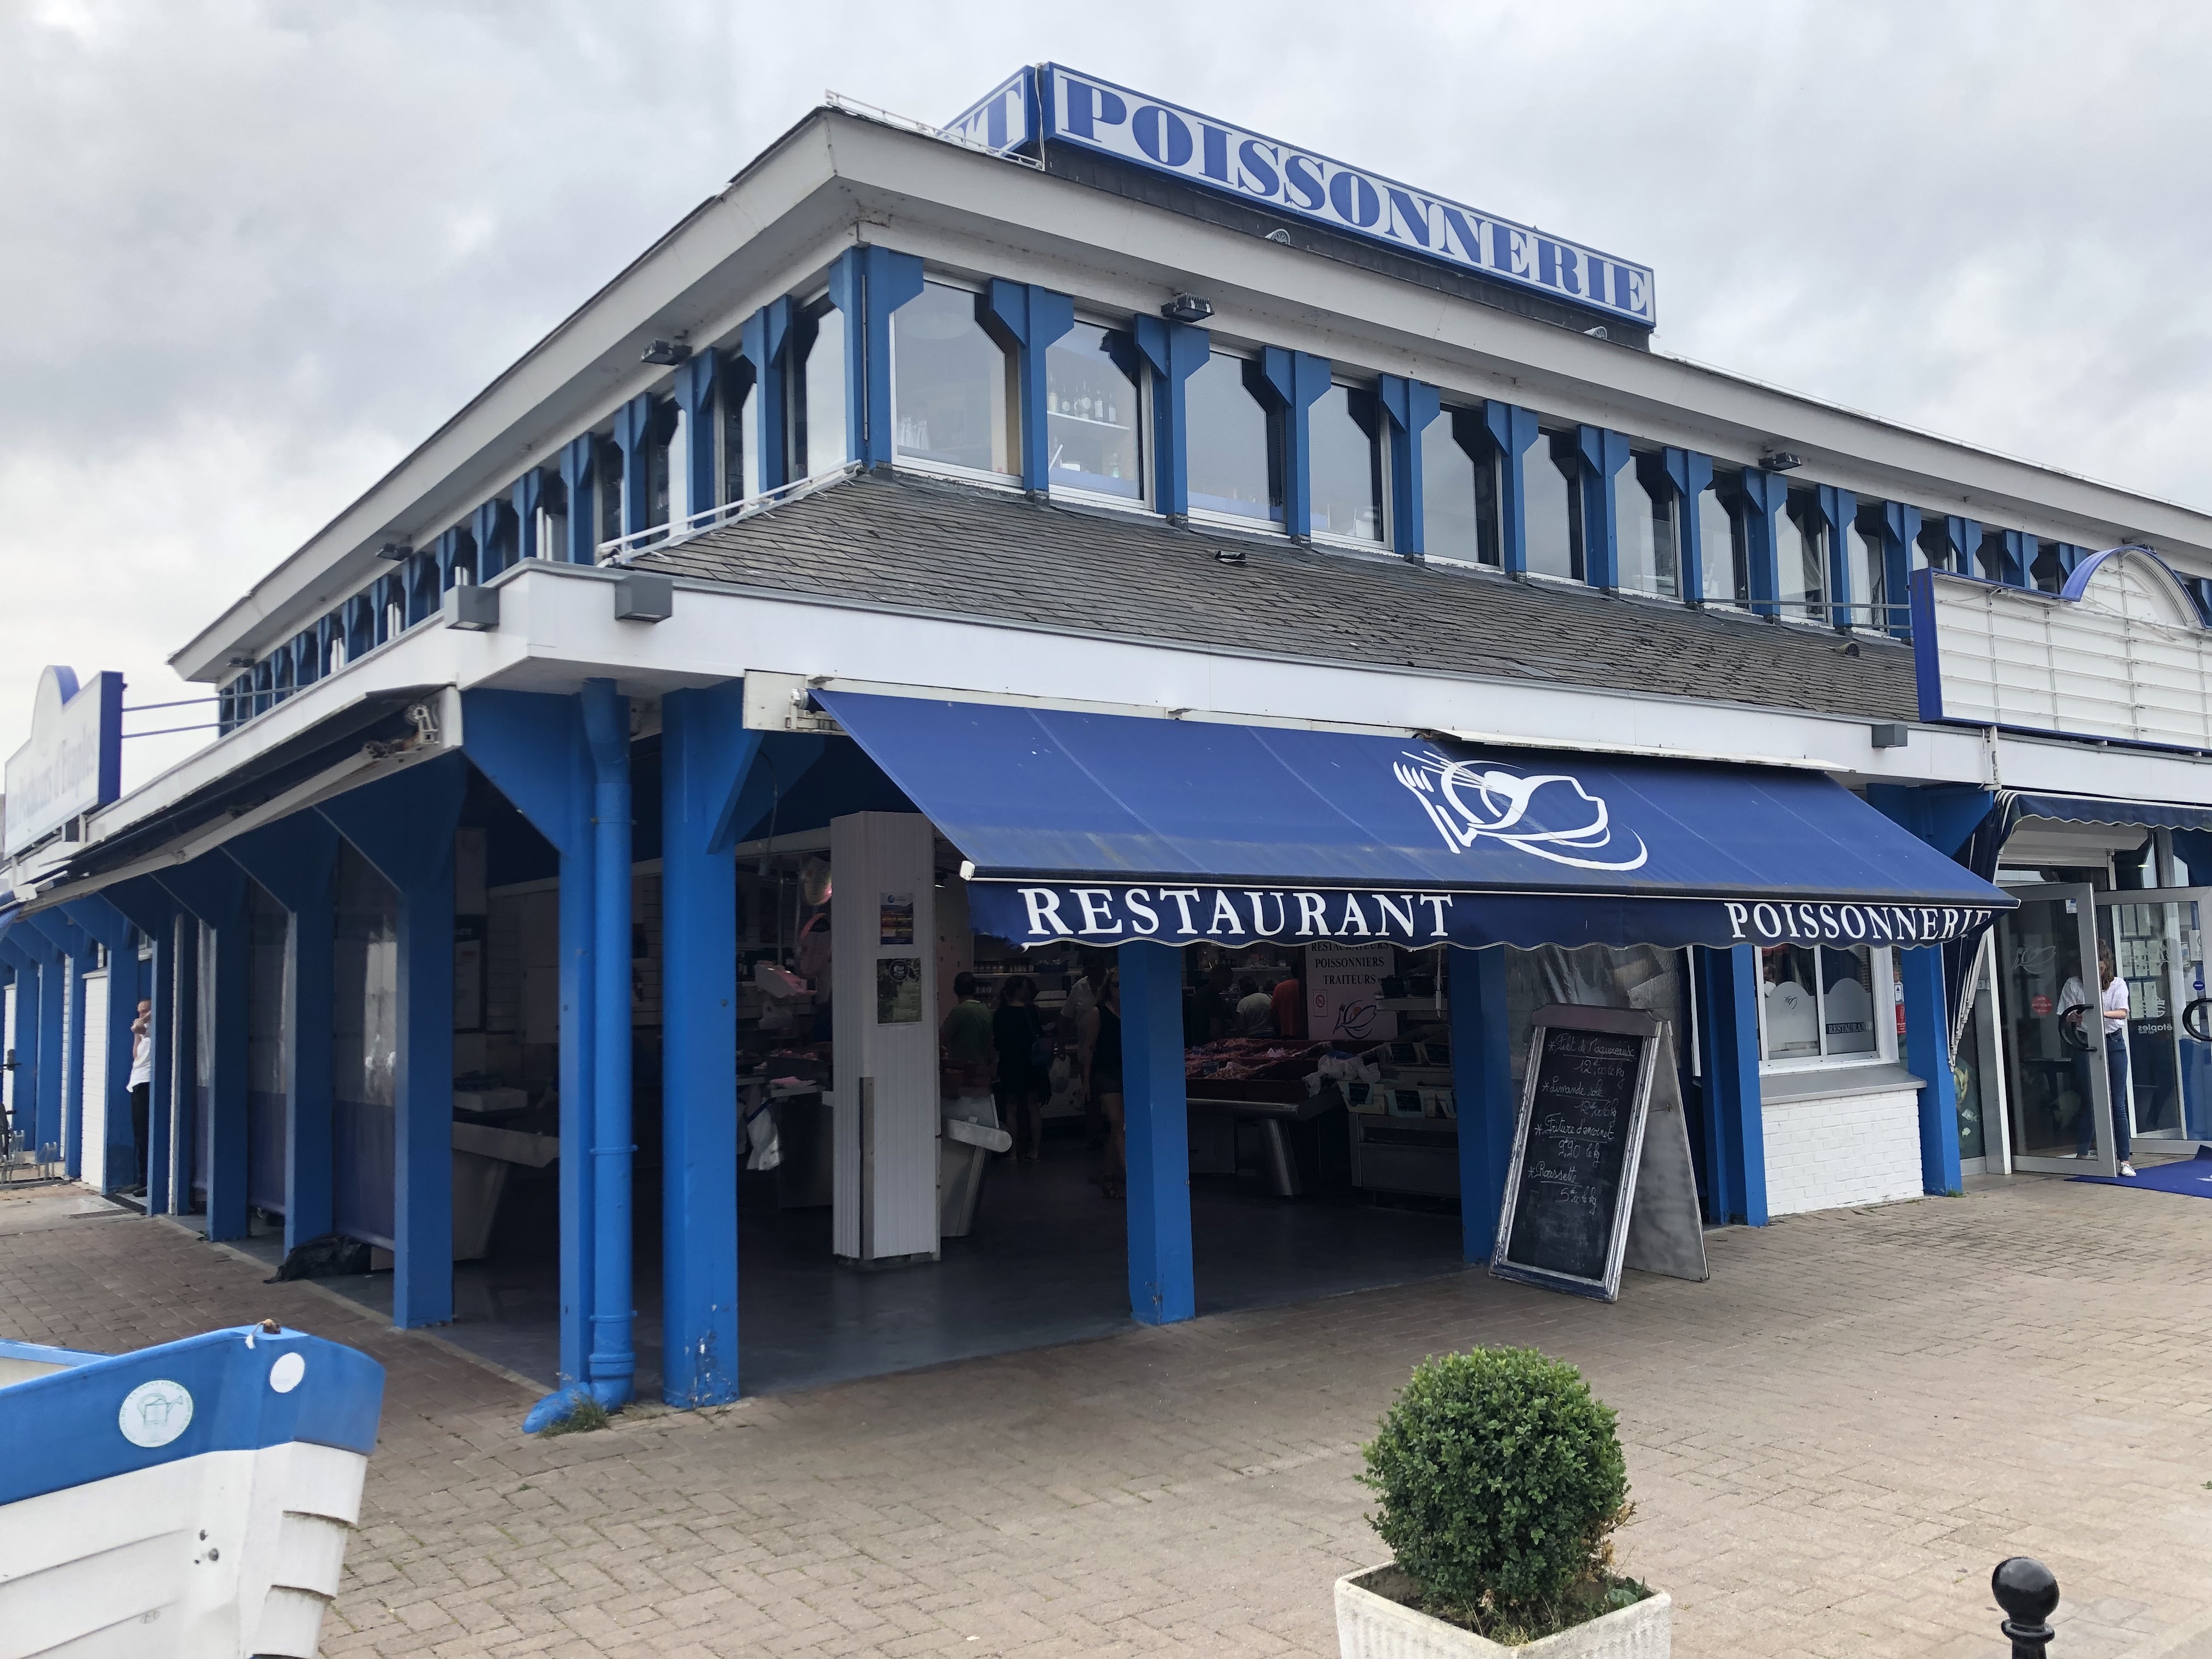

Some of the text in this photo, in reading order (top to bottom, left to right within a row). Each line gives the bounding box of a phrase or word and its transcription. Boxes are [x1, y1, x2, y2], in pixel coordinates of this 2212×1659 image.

[1060, 75, 1647, 317] POISSONNERIE
[1017, 888, 1454, 937] RESTAURANT
[1314, 956, 1384, 968] POISSONNIERS
[1323, 974, 1376, 985] TRAITEURS
